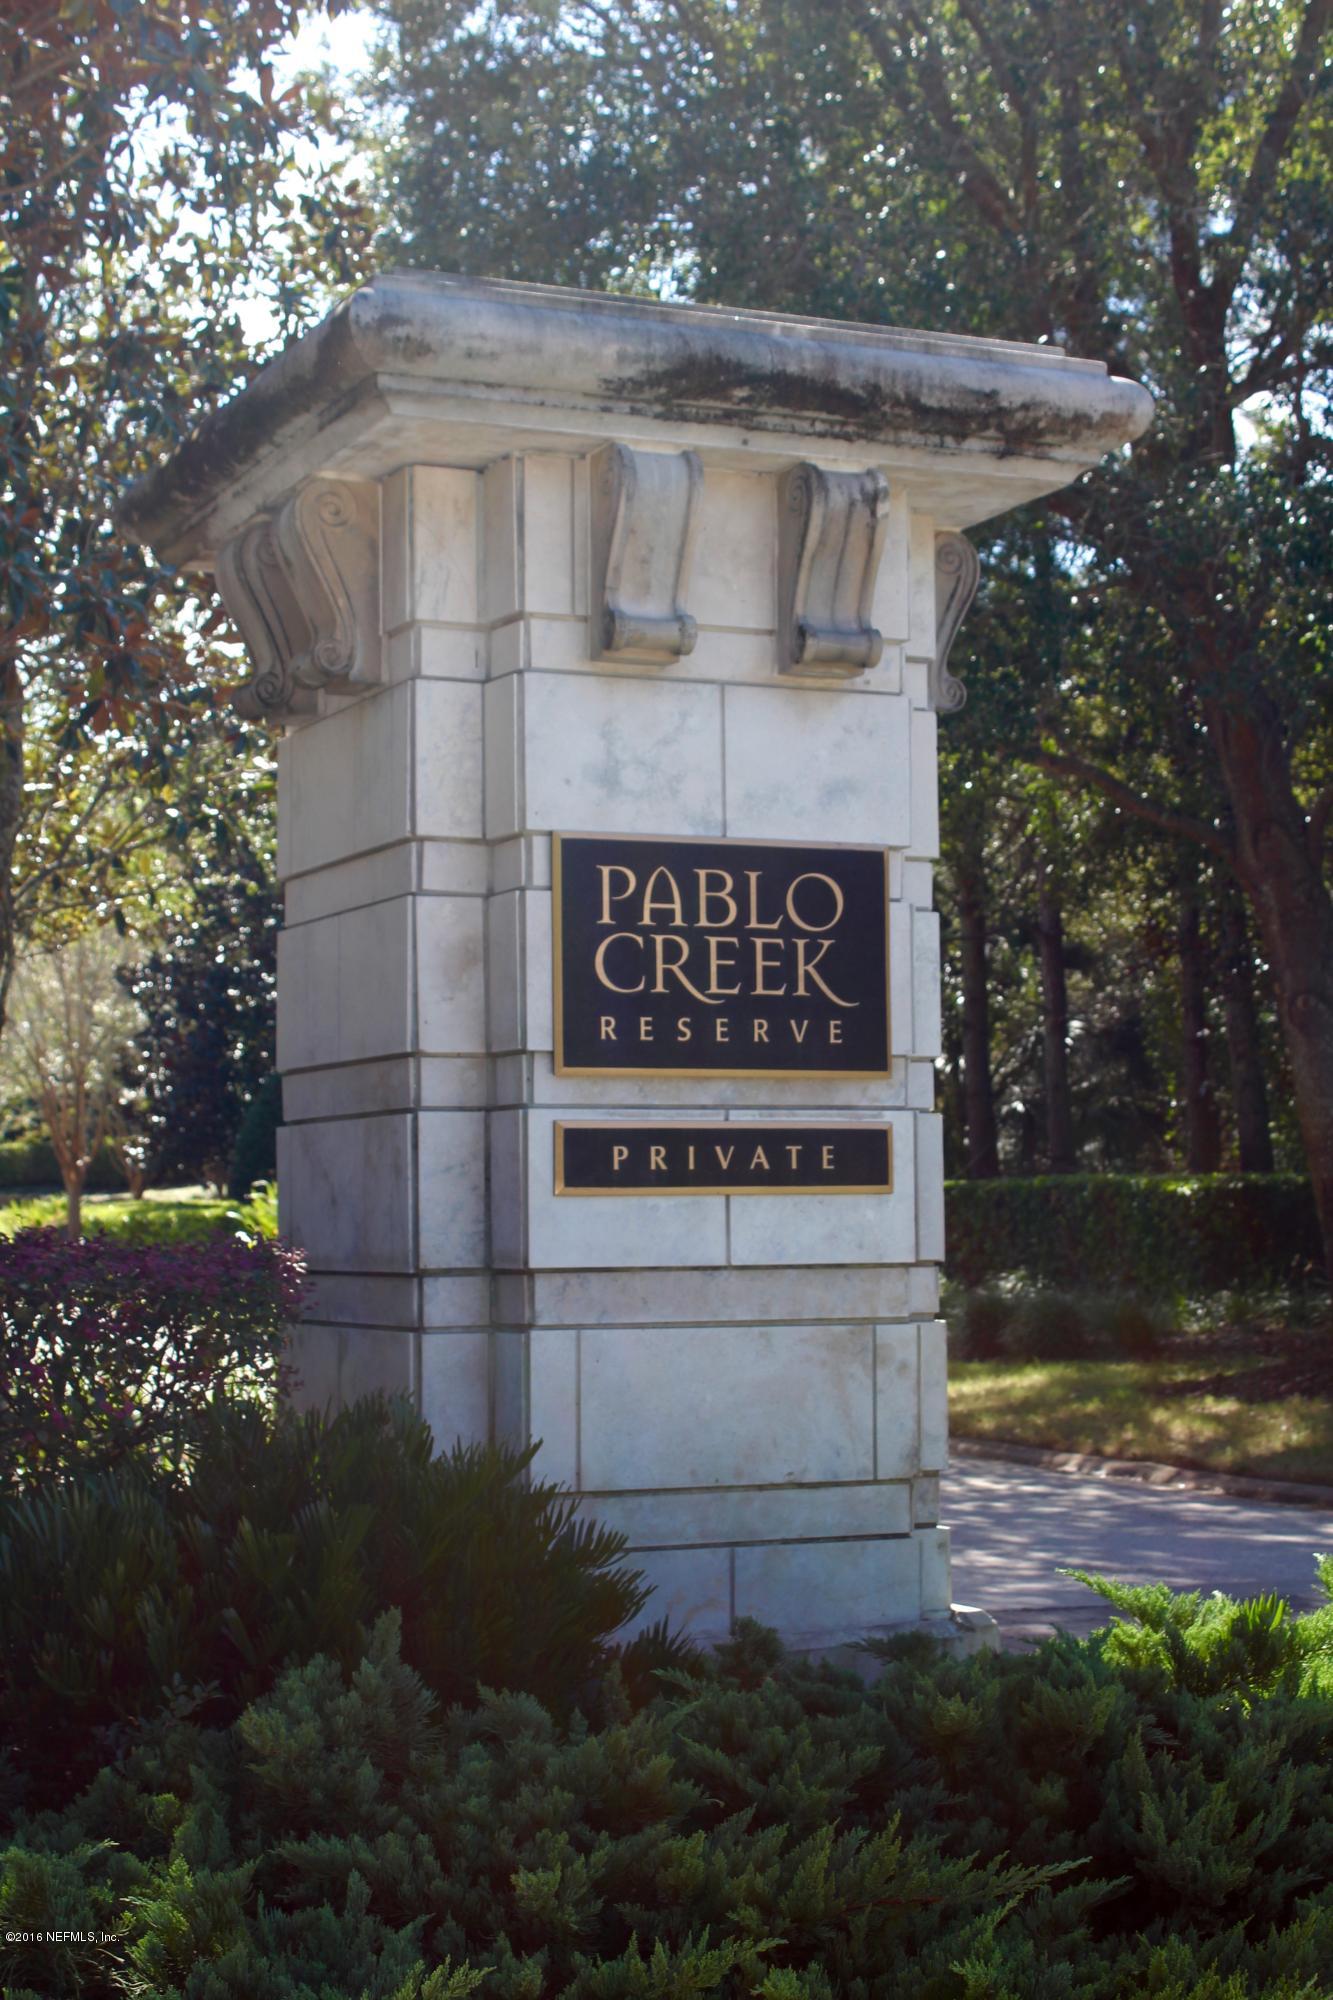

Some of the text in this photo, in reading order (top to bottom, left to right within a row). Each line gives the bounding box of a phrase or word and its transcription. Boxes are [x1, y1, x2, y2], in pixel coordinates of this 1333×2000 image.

[596, 864, 844, 932] PABLO
[594, 932, 860, 1007] CREEK
[600, 1016, 843, 1044] RESERVE
[612, 1145, 835, 1170] PRIVATE
